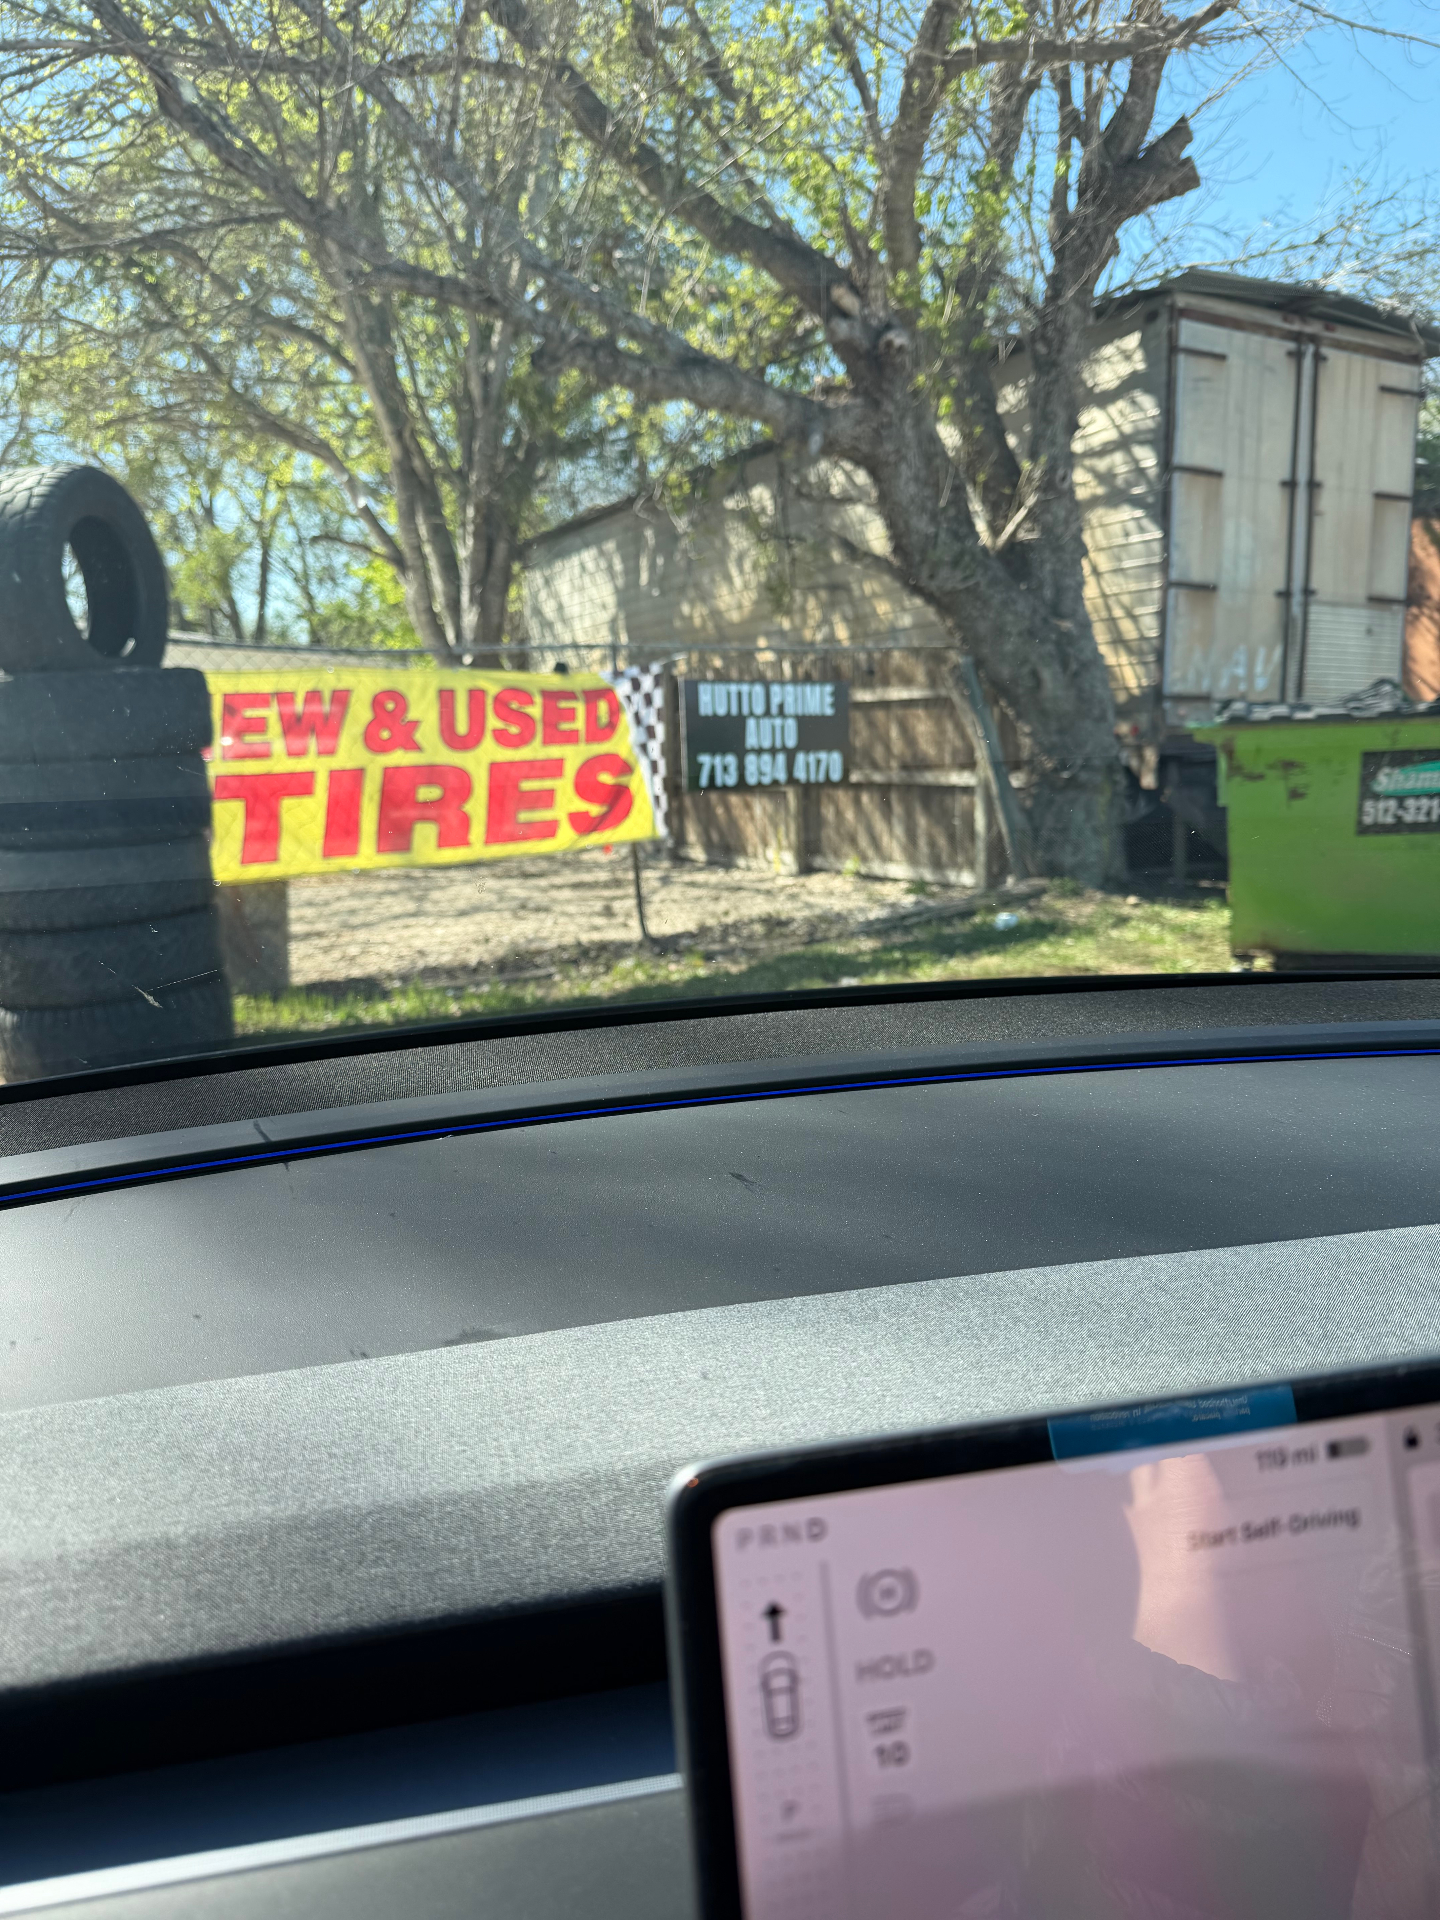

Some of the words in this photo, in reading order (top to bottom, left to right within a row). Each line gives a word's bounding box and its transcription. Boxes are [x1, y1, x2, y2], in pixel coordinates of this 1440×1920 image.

[697, 682, 766, 716] HUTTO
[769, 682, 835, 716] PRIME
[202, 689, 351, 760] EW
[364, 690, 423, 754] &
[439, 688, 621, 751] USED
[745, 716, 799, 750] AUTO
[696, 752, 739, 788] 713
[792, 749, 844, 783] 4170
[213, 753, 634, 866] TIRES
[1362, 797, 1440, 825] 512-321
[854, 1647, 936, 1686] HOLD
